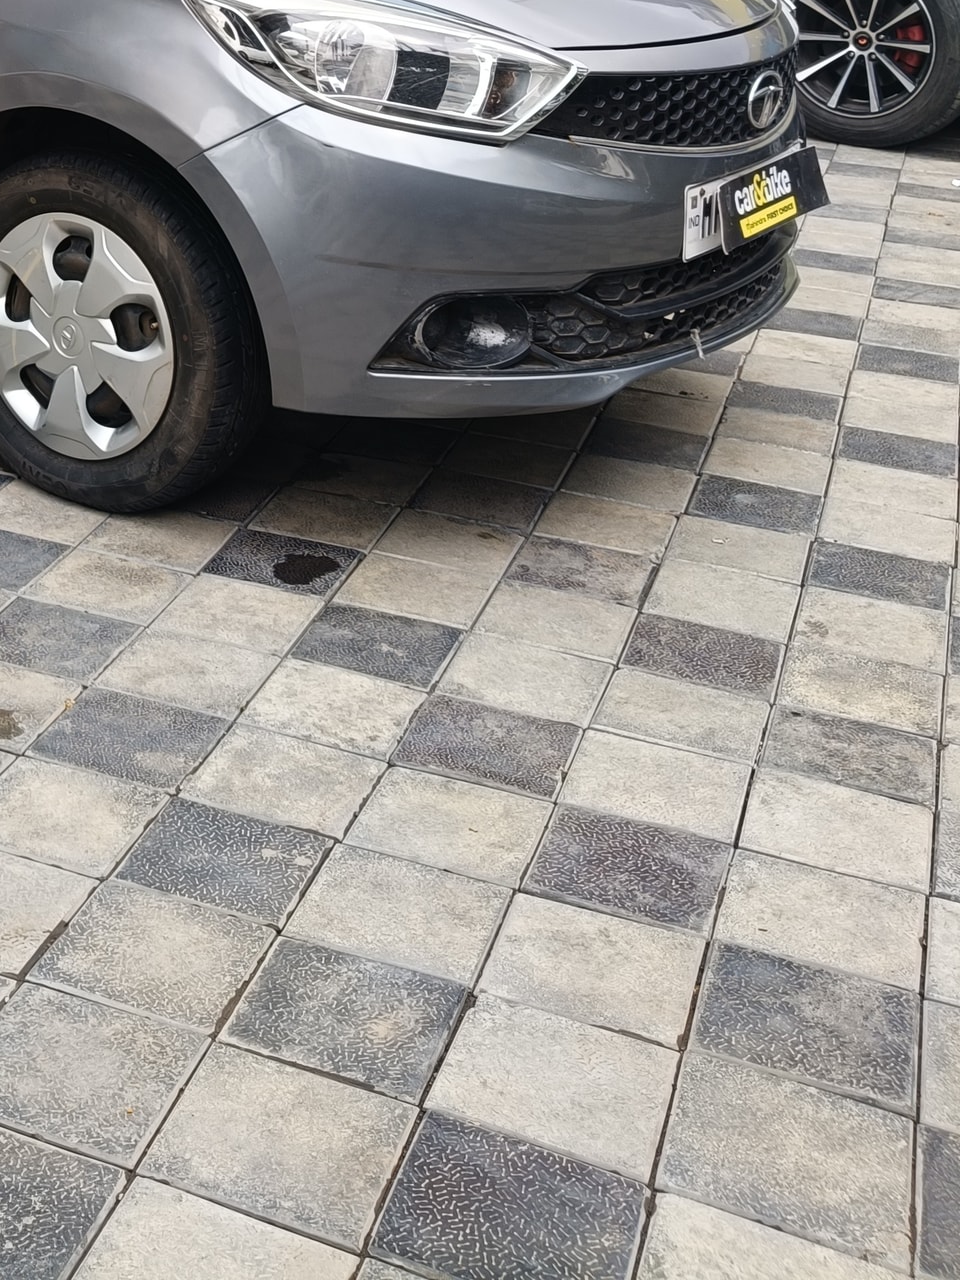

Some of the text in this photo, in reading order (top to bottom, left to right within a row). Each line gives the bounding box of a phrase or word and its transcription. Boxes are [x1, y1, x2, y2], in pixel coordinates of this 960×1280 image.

[734, 166, 792, 215] car&bike
[766, 209, 780, 220] FIRST
[778, 202, 794, 216] CHOICE
